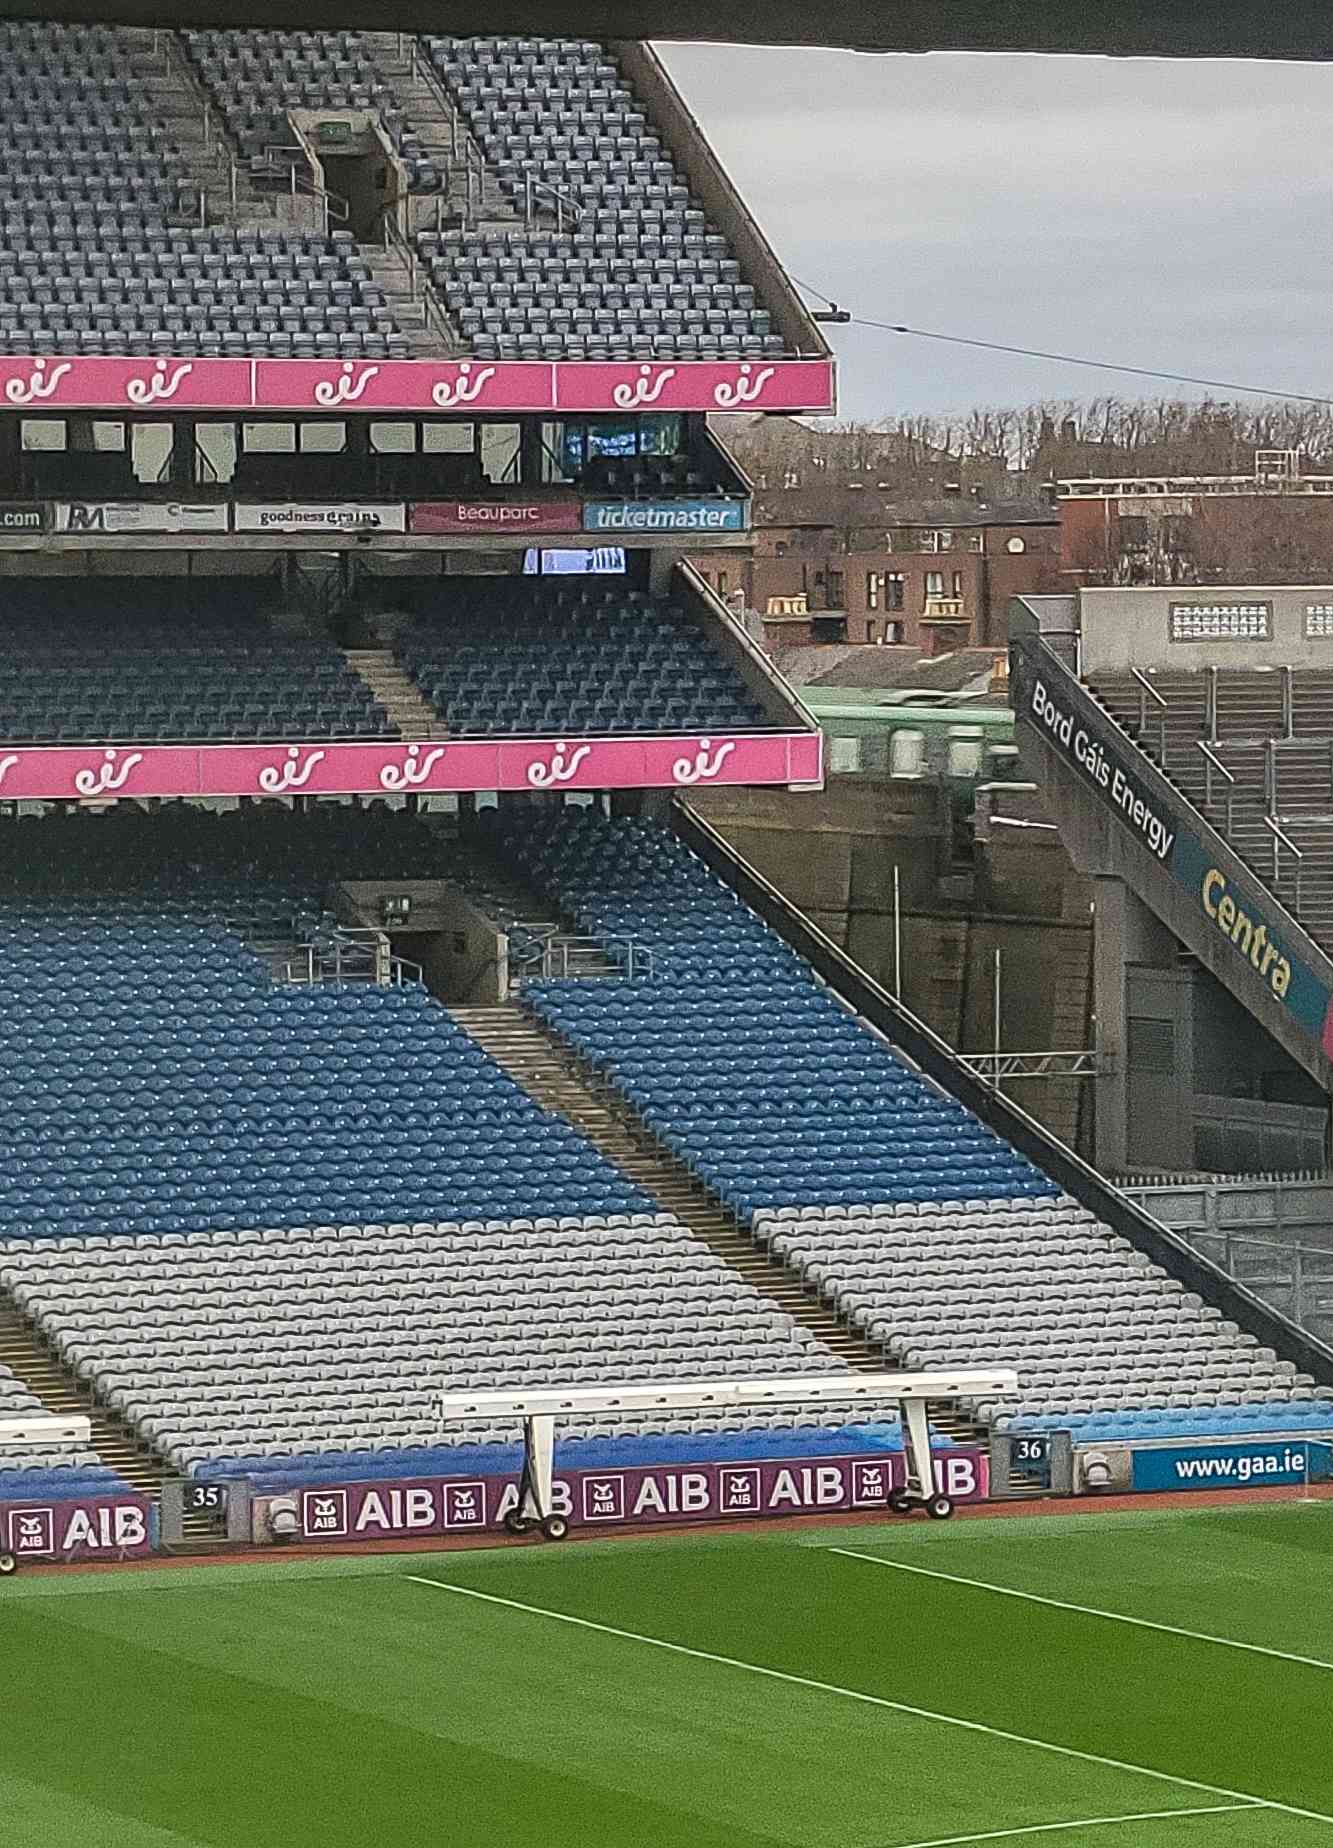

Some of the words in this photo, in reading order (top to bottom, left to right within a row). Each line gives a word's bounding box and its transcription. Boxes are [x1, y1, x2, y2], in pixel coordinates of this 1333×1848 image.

[5, 359, 72, 403] eir
[126, 359, 193, 404] eir
[315, 362, 379, 406] eir
[432, 363, 496, 407] eir
[613, 364, 676, 408] eir
[713, 364, 775, 408] eir
[458, 503, 540, 524] Beauparc
[597, 505, 732, 529] ticketmaster
[75, 750, 143, 795] eir
[258, 747, 326, 792] eir
[380, 744, 444, 790] eir
[527, 741, 591, 787] eir
[672, 739, 736, 784] eir
[1032, 680, 1074, 748] Bord
[1074, 729, 1111, 788] Gáis
[1111, 767, 1174, 859] Energy
[1202, 868, 1291, 998] Centra
[1017, 1440, 1042, 1459] 36
[1176, 1448, 1305, 1481] www.gaa.ie
[192, 1487, 218, 1507] 35
[633, 1474, 710, 1513] AIB
[769, 1466, 844, 1507] AIB
[931, 1458, 976, 1496] IB
[313, 1515, 338, 1531] AIB
[356, 1489, 436, 1531] AIB
[496, 1480, 574, 1523] AB
[62, 1506, 147, 1549] AIB
